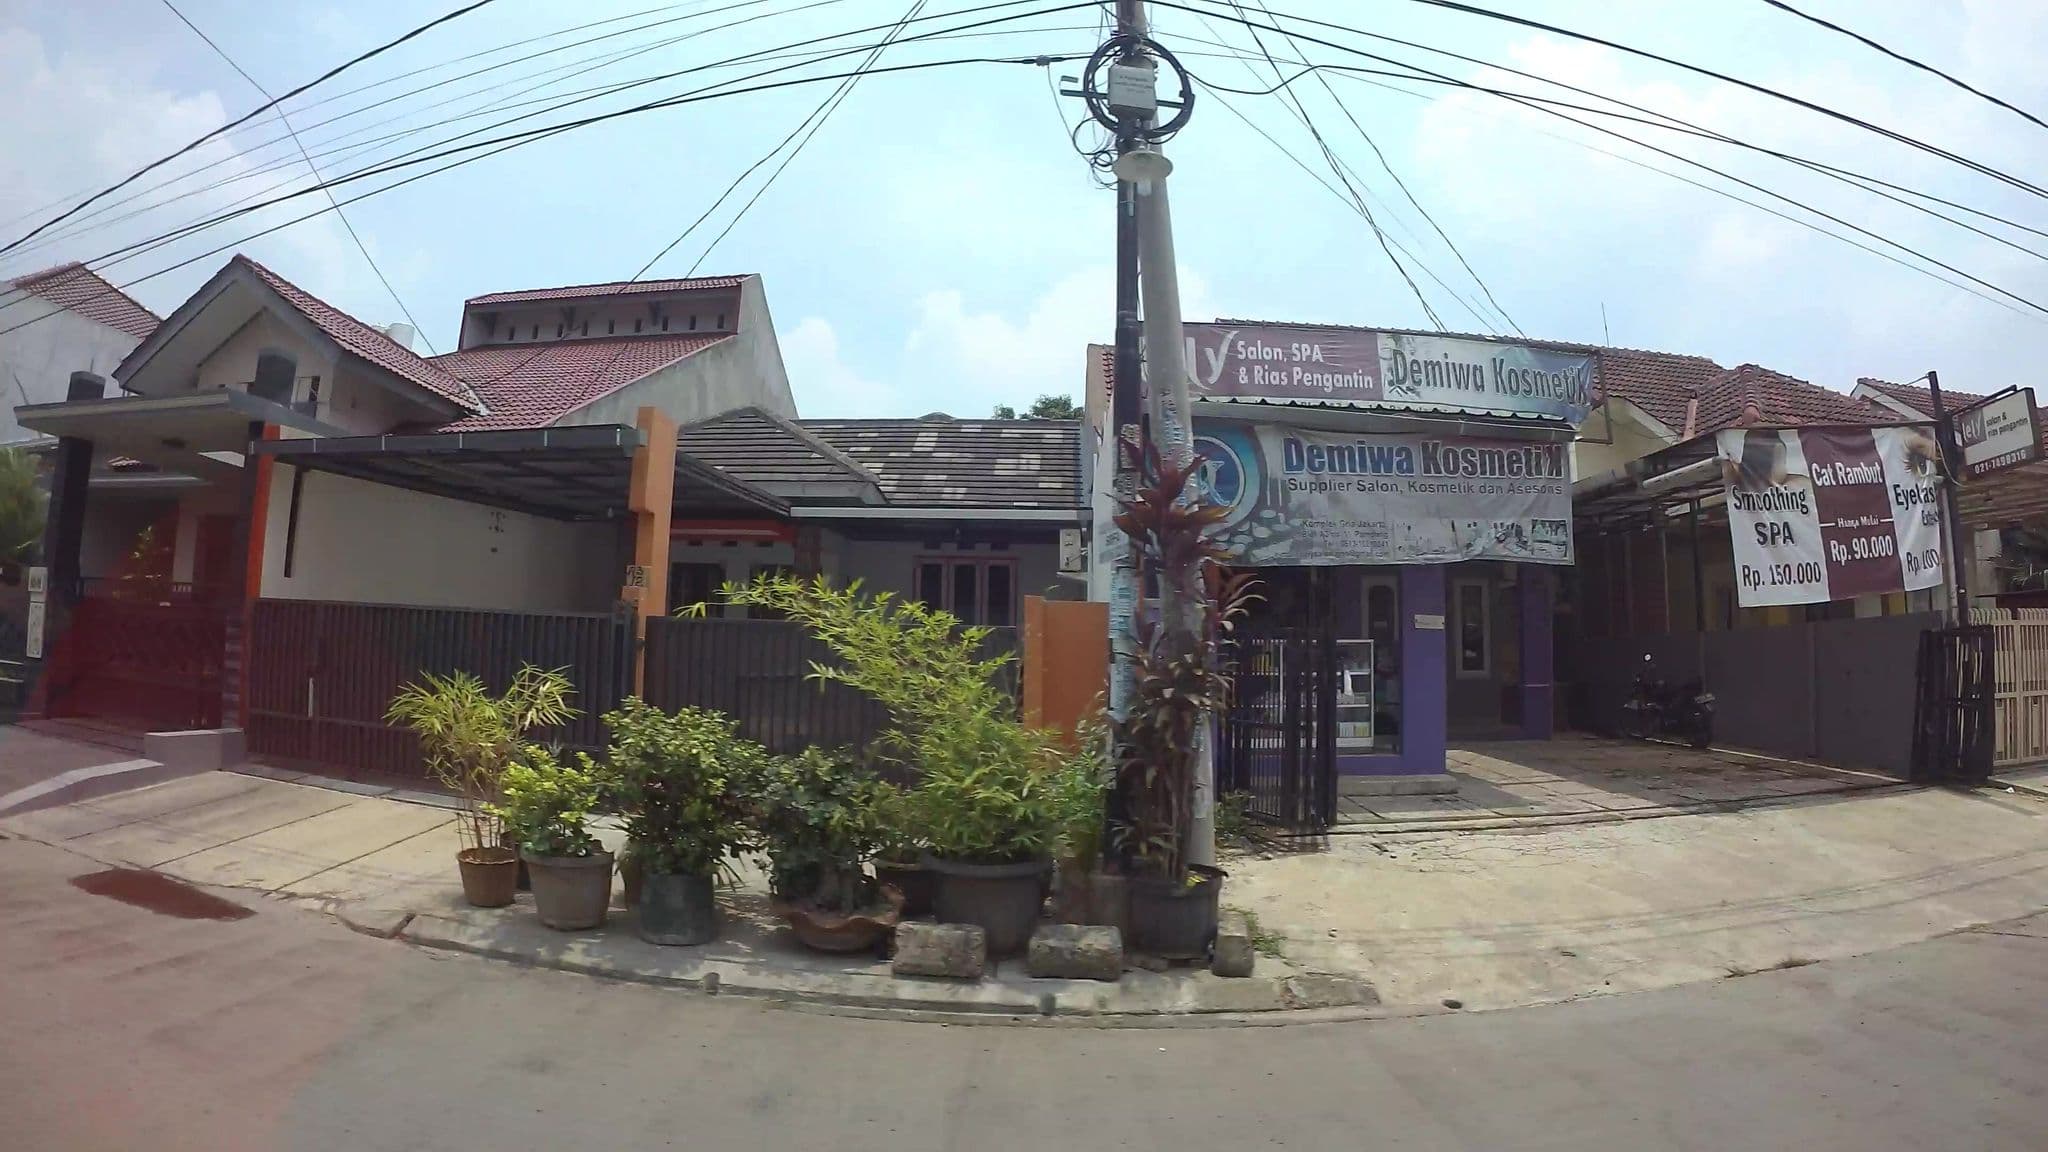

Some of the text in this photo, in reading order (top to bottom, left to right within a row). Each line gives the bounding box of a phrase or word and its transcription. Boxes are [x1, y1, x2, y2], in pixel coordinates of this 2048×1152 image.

[1185, 330, 1239, 390] ly
[1237, 340, 1324, 363] Salon, SPA
[1238, 365, 1373, 393] & Rias Pengantin
[1392, 348, 1485, 393] Demiwa
[1283, 437, 1415, 477] Demiwa
[1288, 478, 1352, 494] Supplier
[1356, 479, 1403, 494] Salon,
[1408, 480, 1475, 494] Kosmetik
[1479, 483, 1502, 494] dan
[1811, 461, 1883, 486] Cat Rambut
[1732, 485, 1809, 515] Smoothing
[1893, 483, 1937, 511] Eyelas
[1754, 521, 1795, 546] SPA
[1830, 535, 1894, 566] Rp. 90.000
[1922, 548, 1940, 570] 100
[1742, 562, 1821, 591] Rp. 150.000
